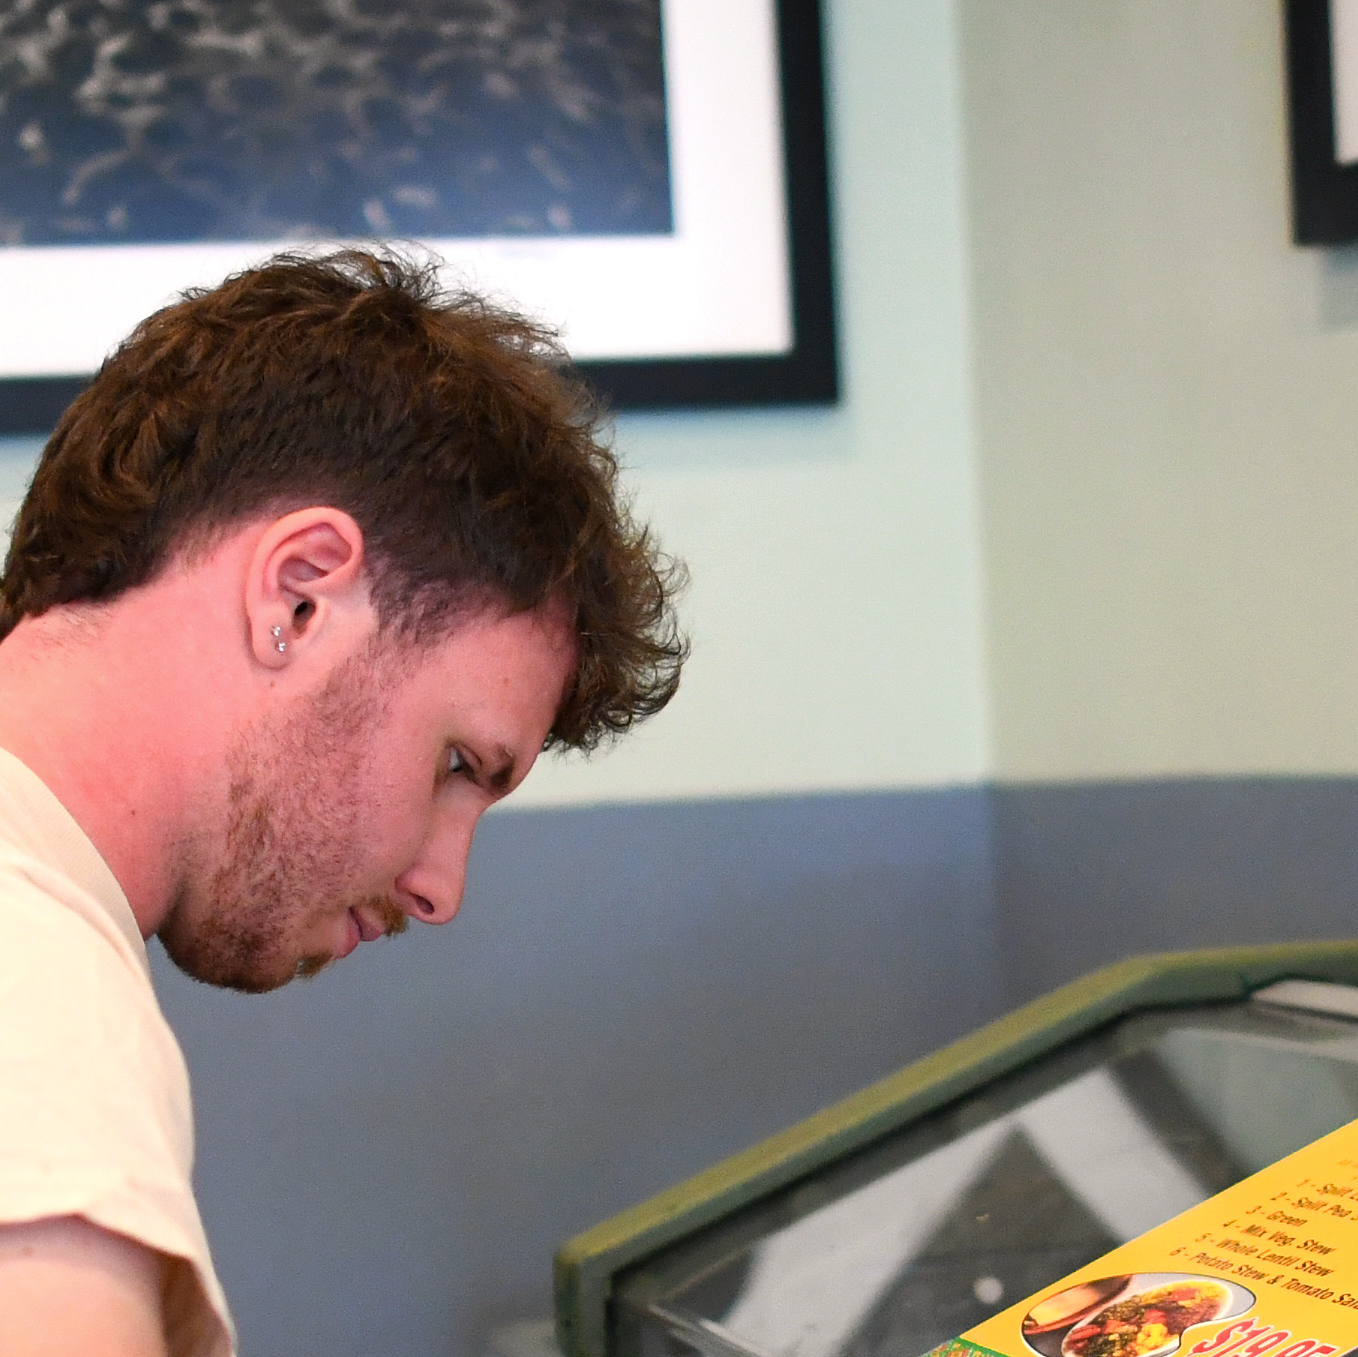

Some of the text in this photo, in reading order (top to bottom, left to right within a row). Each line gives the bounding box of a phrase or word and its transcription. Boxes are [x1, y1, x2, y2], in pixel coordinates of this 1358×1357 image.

[1266, 1210, 1308, 1227] Green
[1323, 1204, 1353, 1218] Pea
[1240, 1224, 1267, 1238] Mix
[1268, 1231, 1296, 1246] Veg.
[1296, 1239, 1337, 1255] Stew
[1215, 1237, 1259, 1256] Whole
[1256, 1249, 1300, 1268] Lentil
[1294, 1260, 1335, 1277] Stew
[1188, 1252, 1234, 1271] Potato
[1231, 1264, 1270, 1281] Stew
[1265, 1274, 1284, 1286] &
[1280, 1278, 1335, 1300] Tomato
